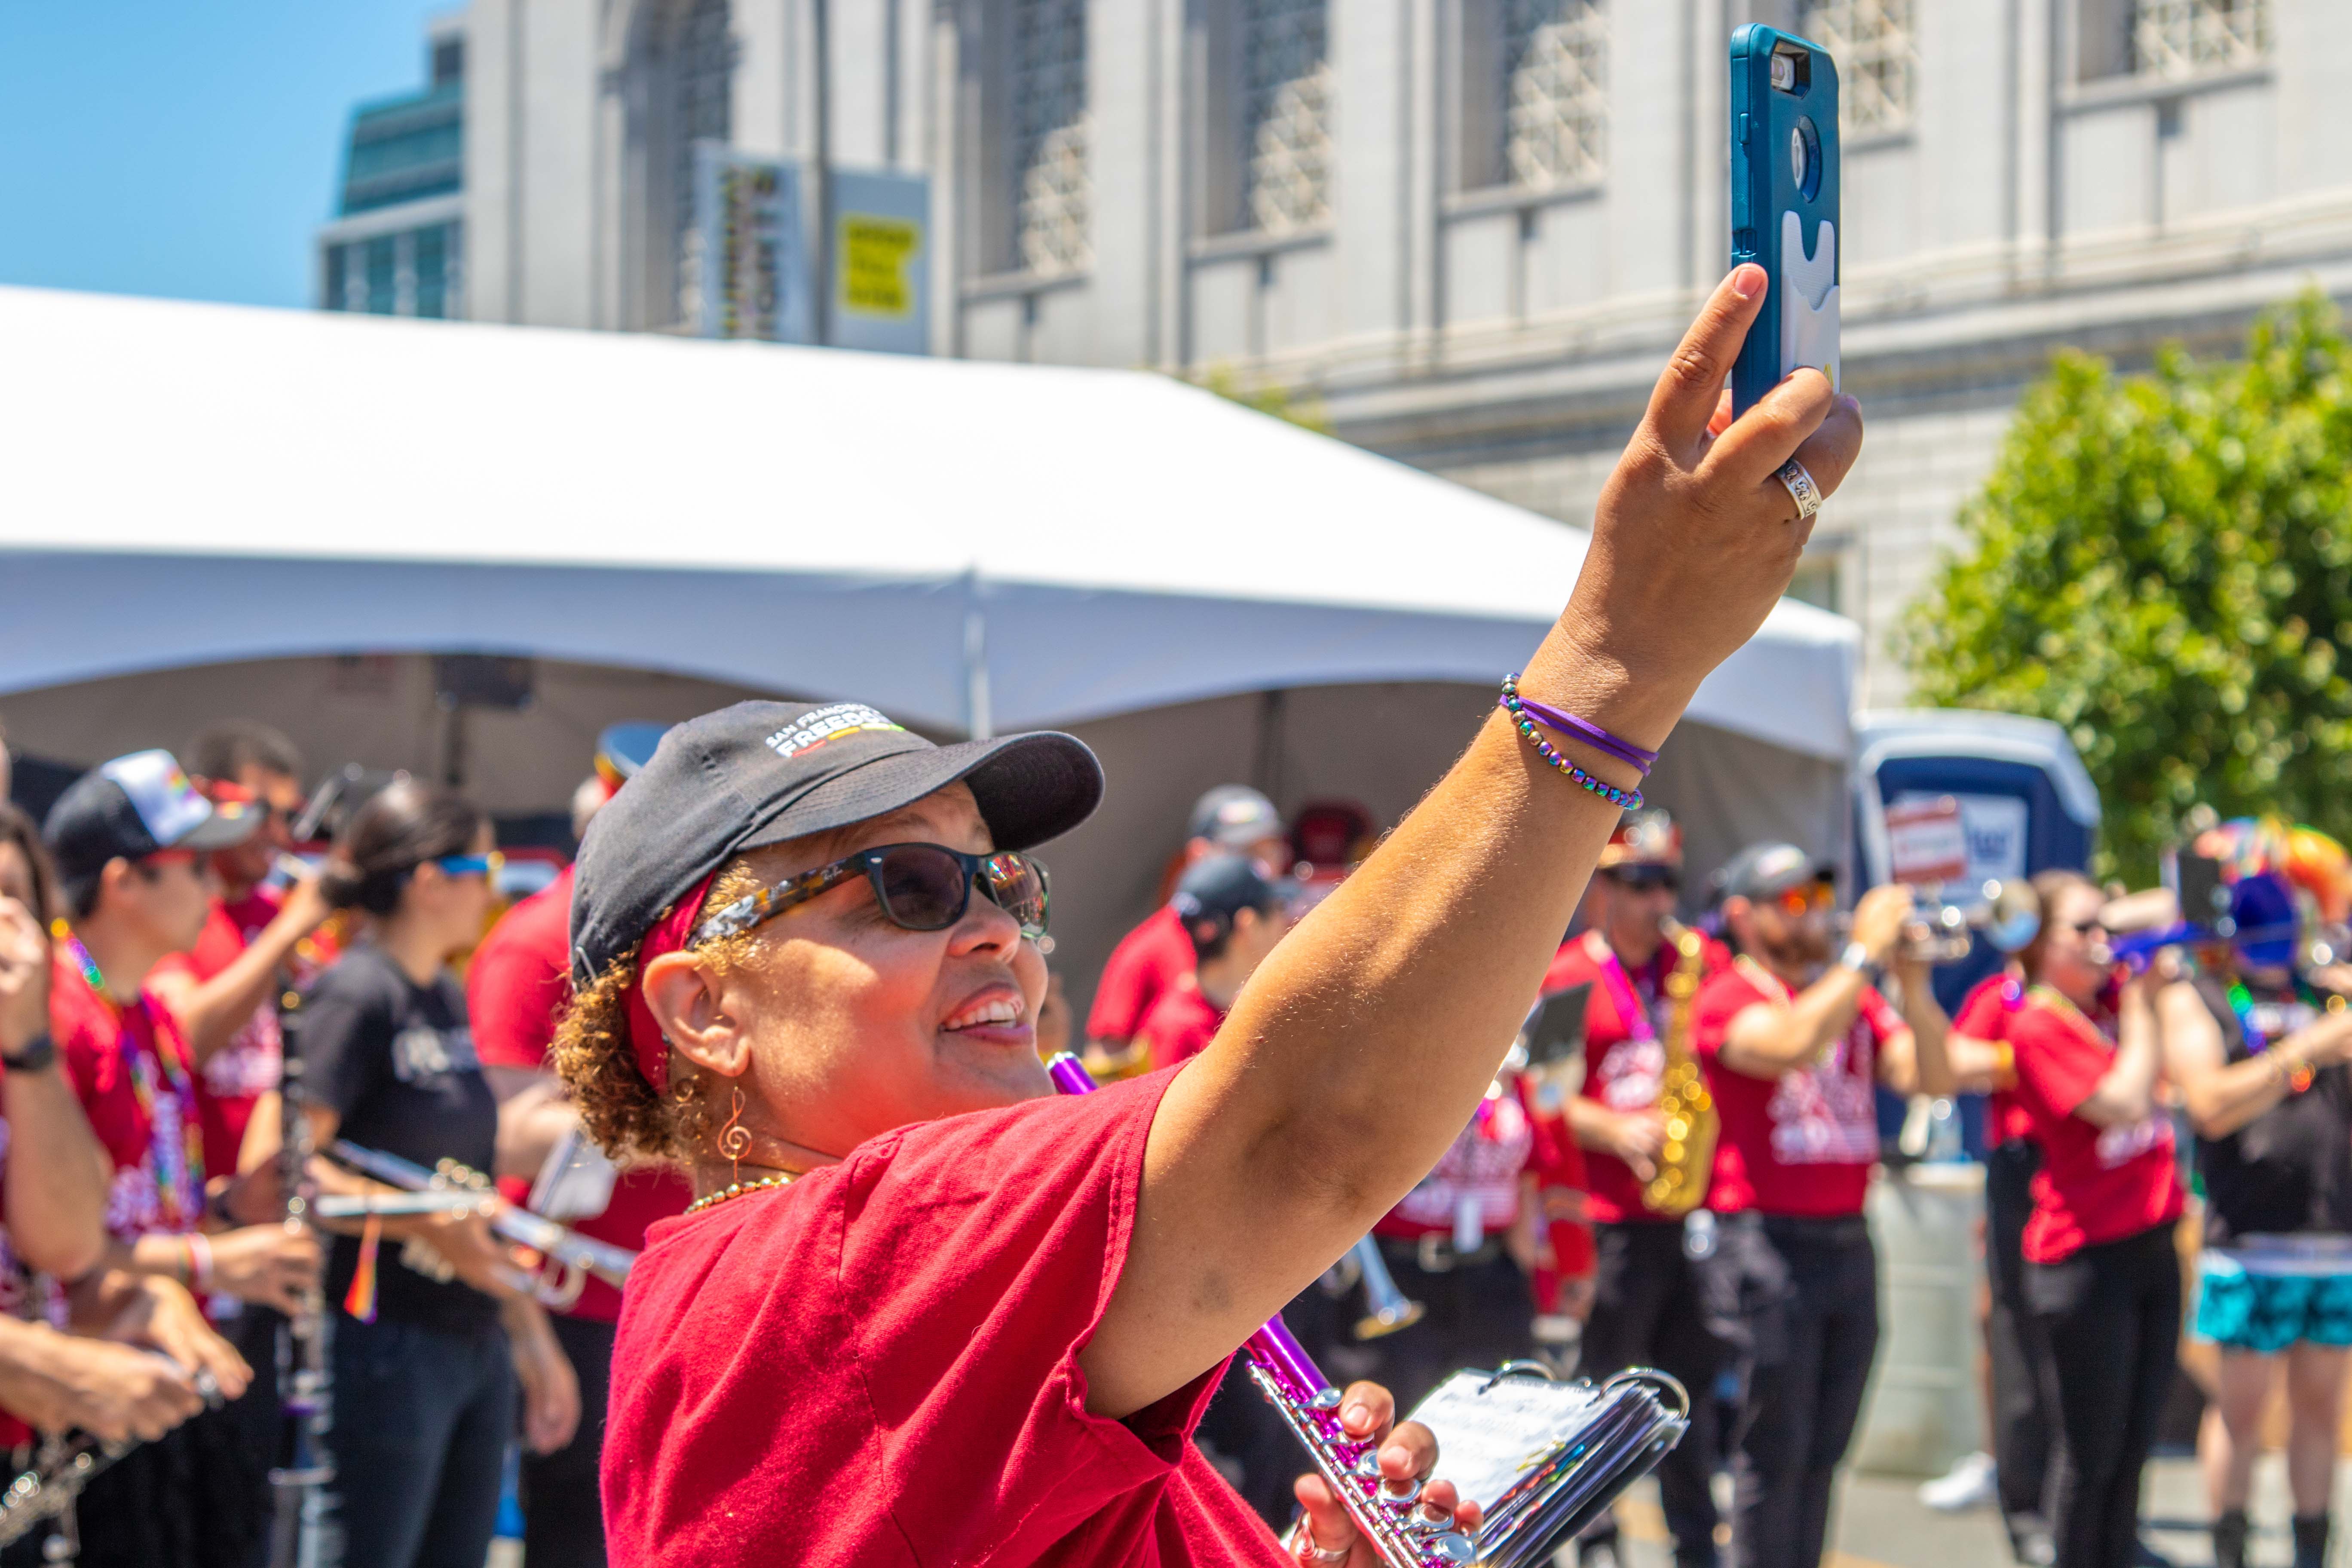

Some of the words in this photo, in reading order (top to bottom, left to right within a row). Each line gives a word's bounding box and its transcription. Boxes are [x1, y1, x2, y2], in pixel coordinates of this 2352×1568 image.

[765, 724, 798, 748] SAN
[796, 703, 880, 728] FRANCIS
[775, 710, 886, 758] FREEDO
